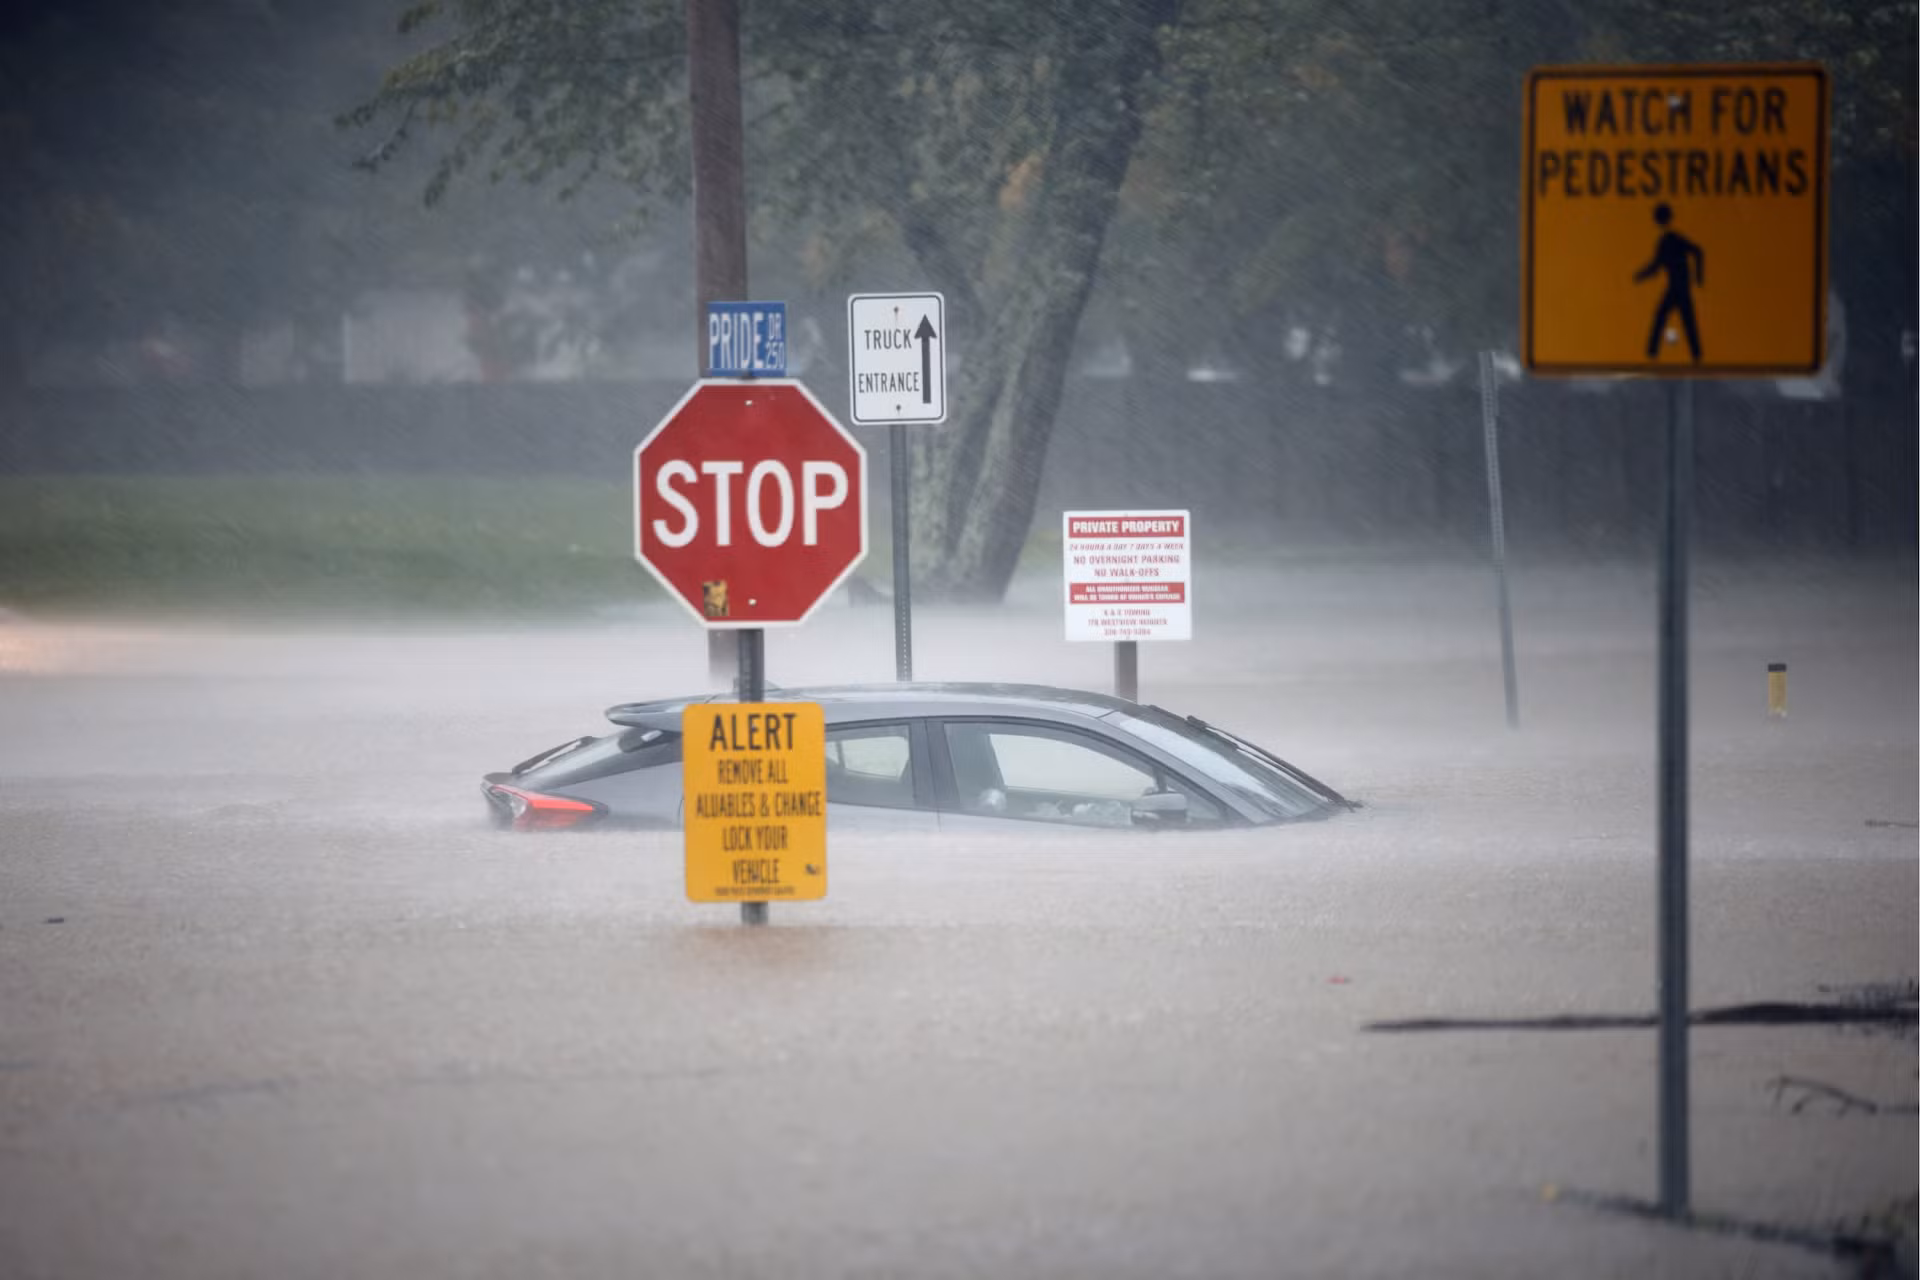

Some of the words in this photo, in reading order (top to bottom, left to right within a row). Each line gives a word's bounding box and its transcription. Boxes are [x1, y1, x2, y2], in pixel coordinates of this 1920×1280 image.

[1563, 87, 1692, 136] WATCH
[1711, 86, 1787, 135] FOR
[1540, 149, 1809, 197] PEDESTRIANS
[709, 312, 764, 369] PRIDE
[768, 312, 782, 340] DR
[864, 328, 912, 350] TRUCK
[765, 341, 784, 369] 250
[858, 372, 920, 393] ENTRANCE
[653, 459, 849, 547] STOP
[1073, 521, 1119, 533] PRIVATE
[1122, 520, 1180, 533] PROPERTY
[1073, 556, 1086, 565] NO
[1089, 556, 1138, 564] OVERNIGHT
[1142, 555, 1180, 563] PARKING
[1094, 568, 1106, 577] NO
[1110, 568, 1159, 576] WALK-OFFS
[709, 713, 797, 751] ALERT
[718, 760, 763, 784] REMOVE
[769, 759, 788, 784] ALL
[761, 793, 770, 817] &
[776, 792, 822, 817] CHANGE
[723, 826, 752, 851] LOCK
[757, 826, 788, 850] YOUR
[733, 859, 779, 883] VEHICLE
